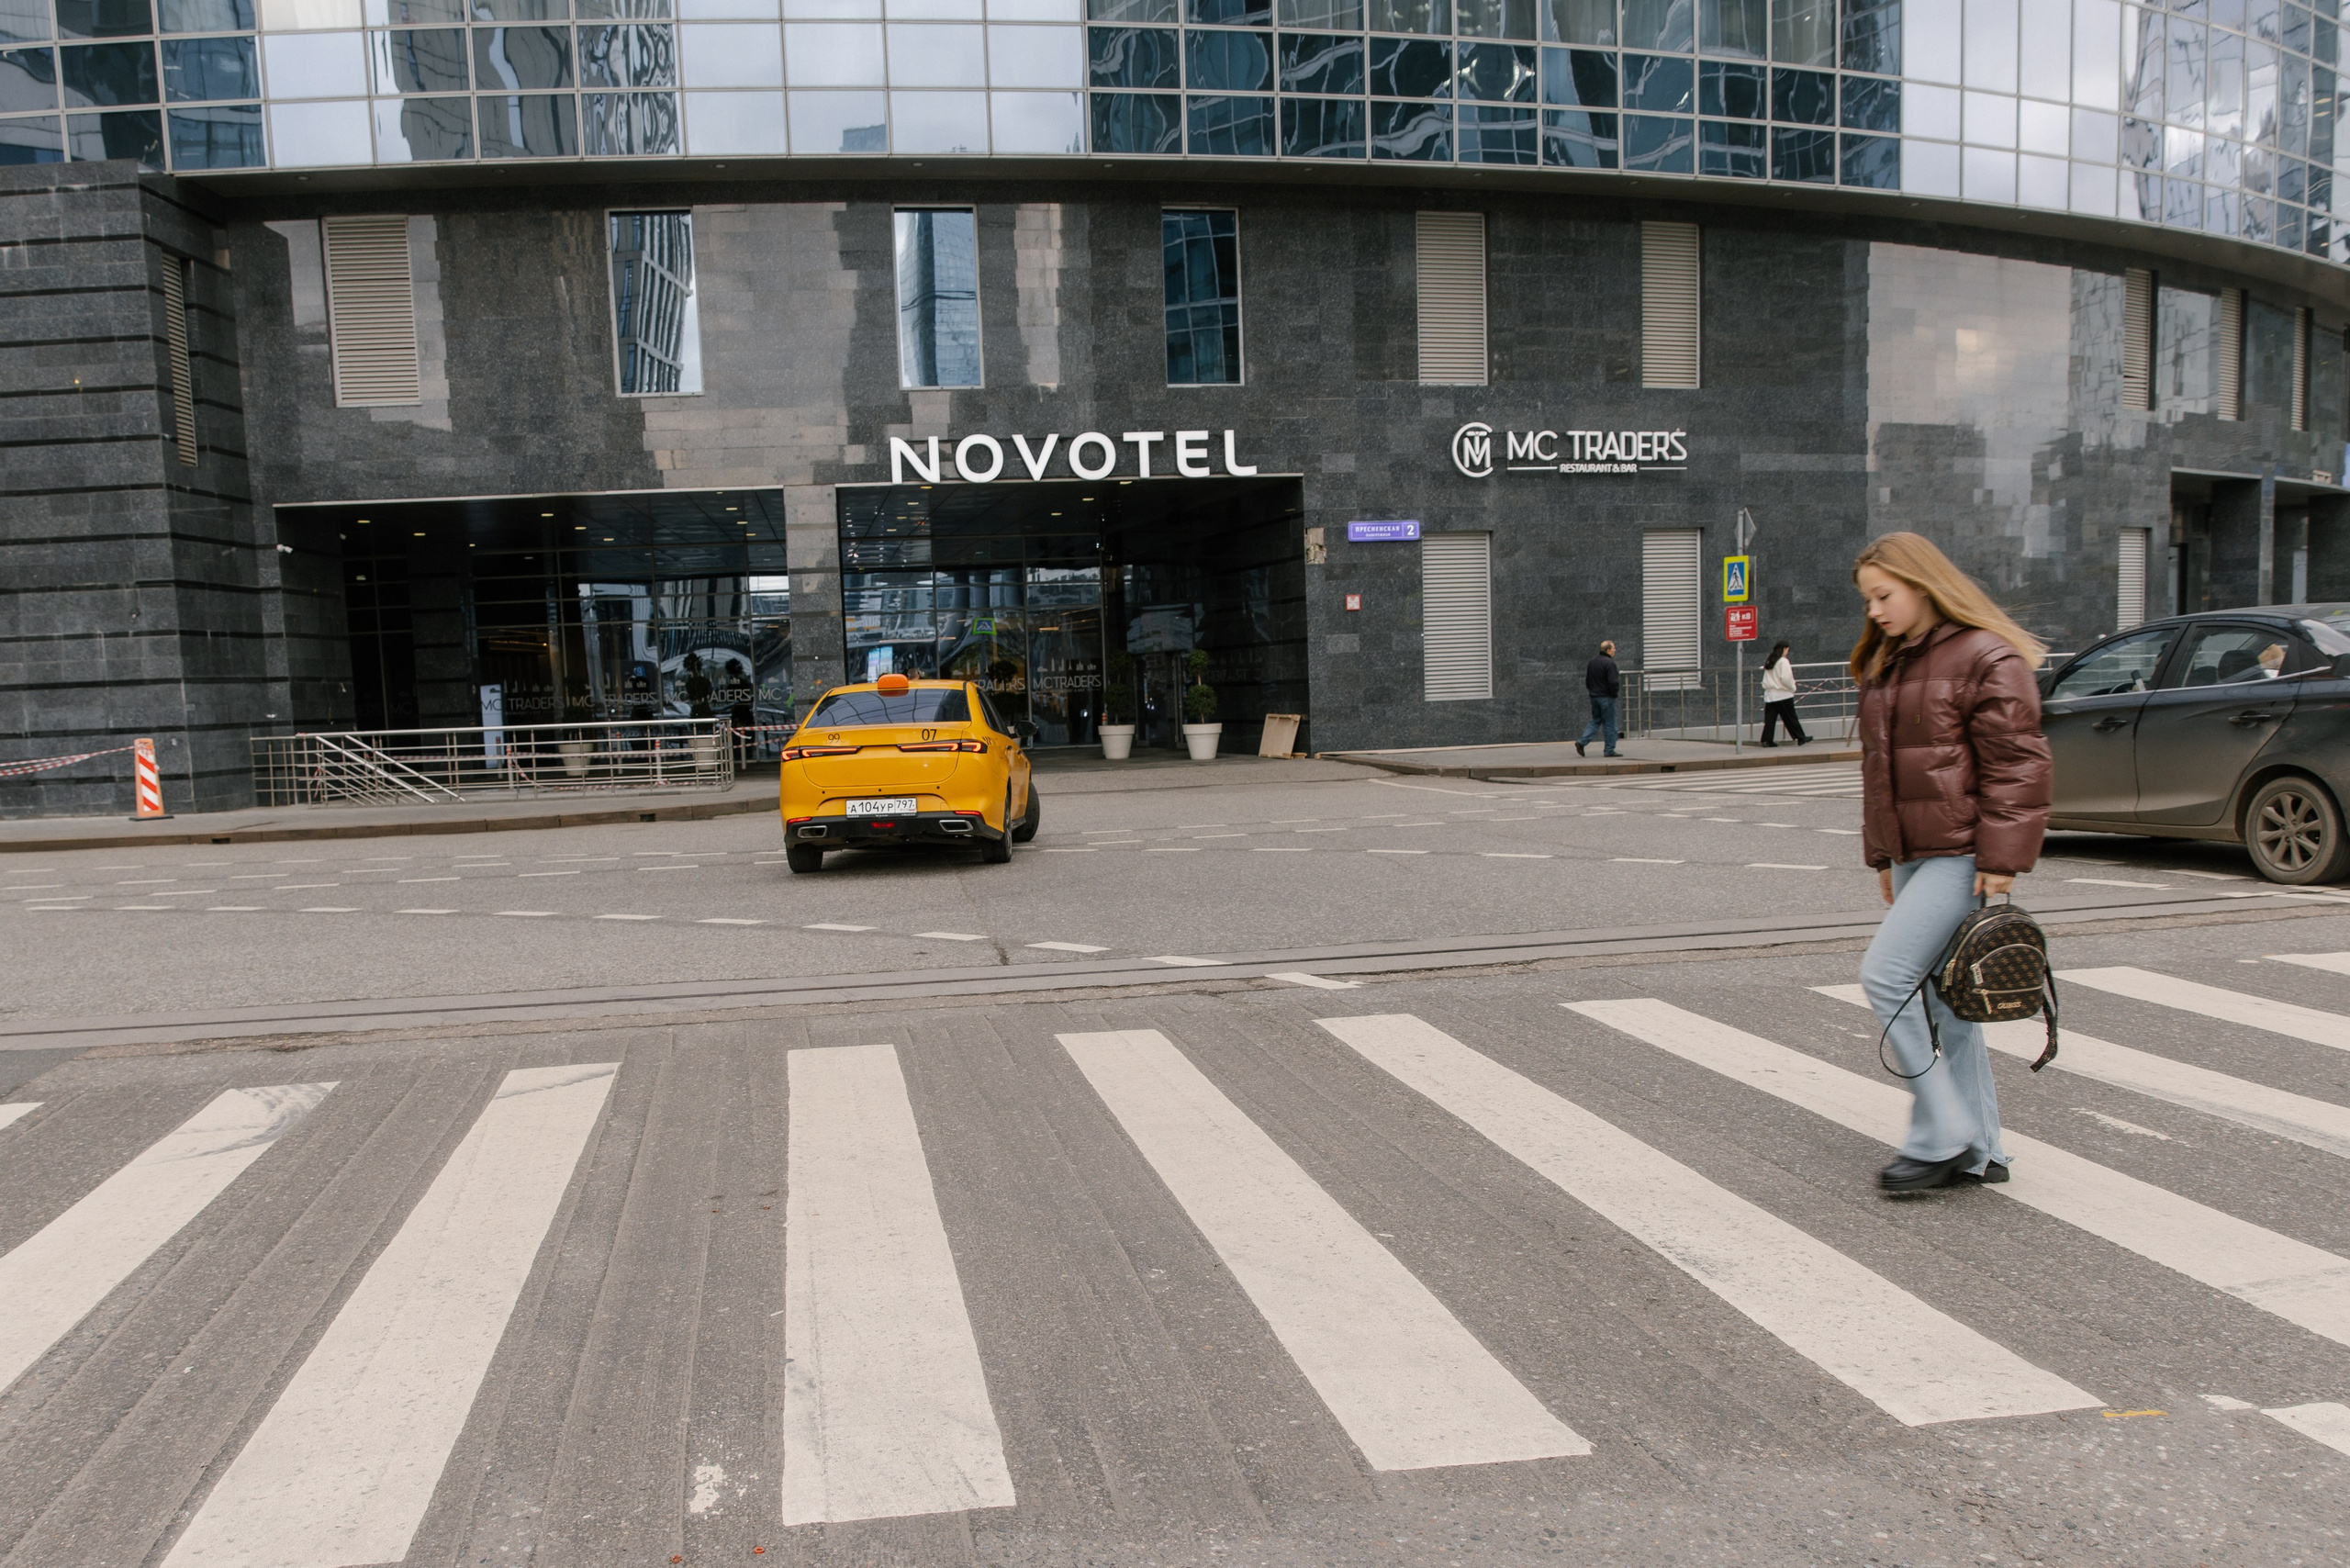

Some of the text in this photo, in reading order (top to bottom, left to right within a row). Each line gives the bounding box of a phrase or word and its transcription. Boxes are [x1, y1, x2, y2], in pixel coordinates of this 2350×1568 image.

[1506, 430, 1688, 462] MC TRADERS
[890, 430, 1258, 484] NOVOTEL
[1559, 463, 1612, 474] RESTAURANT
[1620, 463, 1638, 473] BAR
[1406, 524, 1415, 536] 2
[1033, 675, 1102, 689] MC TRADERS
[708, 689, 752, 702] ADERS
[758, 689, 782, 701] MC
[507, 696, 565, 711] TRADERS
[921, 728, 937, 742] 07
[896, 800, 913, 809] 797
